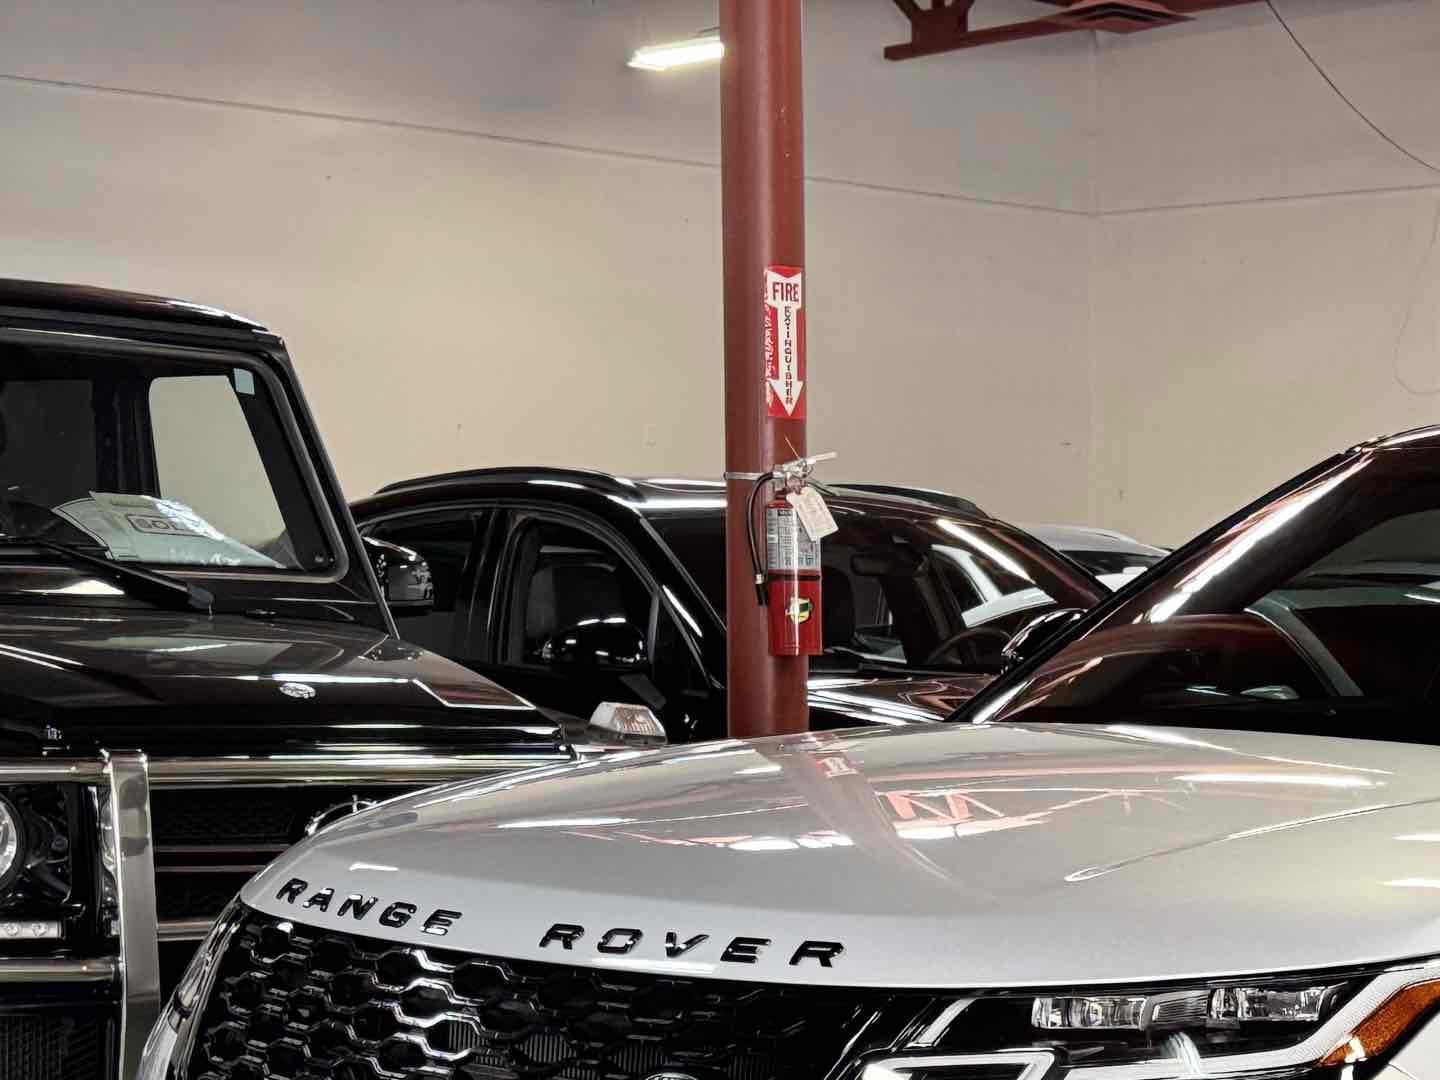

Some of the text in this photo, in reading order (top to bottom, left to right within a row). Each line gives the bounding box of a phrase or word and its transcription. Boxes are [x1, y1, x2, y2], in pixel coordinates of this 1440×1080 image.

[772, 282, 799, 302] FIRE
[275, 877, 845, 968] RANGE ROVER
